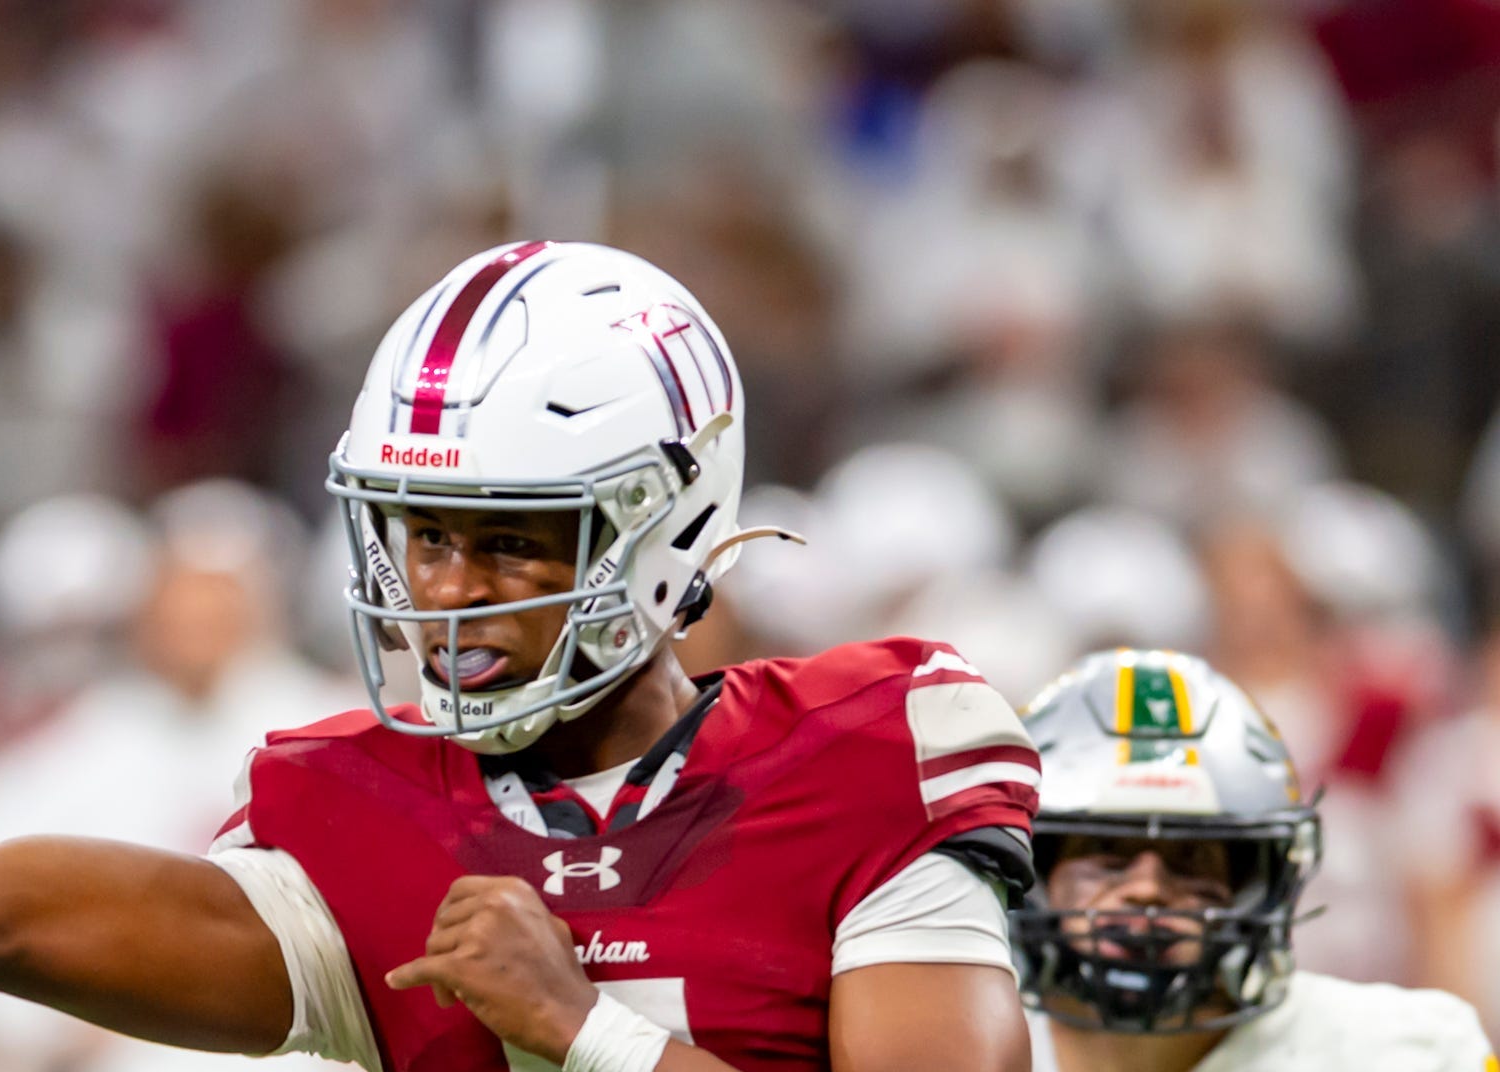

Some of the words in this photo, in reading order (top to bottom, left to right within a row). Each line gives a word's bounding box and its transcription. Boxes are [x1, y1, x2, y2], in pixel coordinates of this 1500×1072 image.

[380, 444, 460, 468] Riddell
[366, 540, 411, 612] Riddell
[440, 698, 493, 716] Ridell
